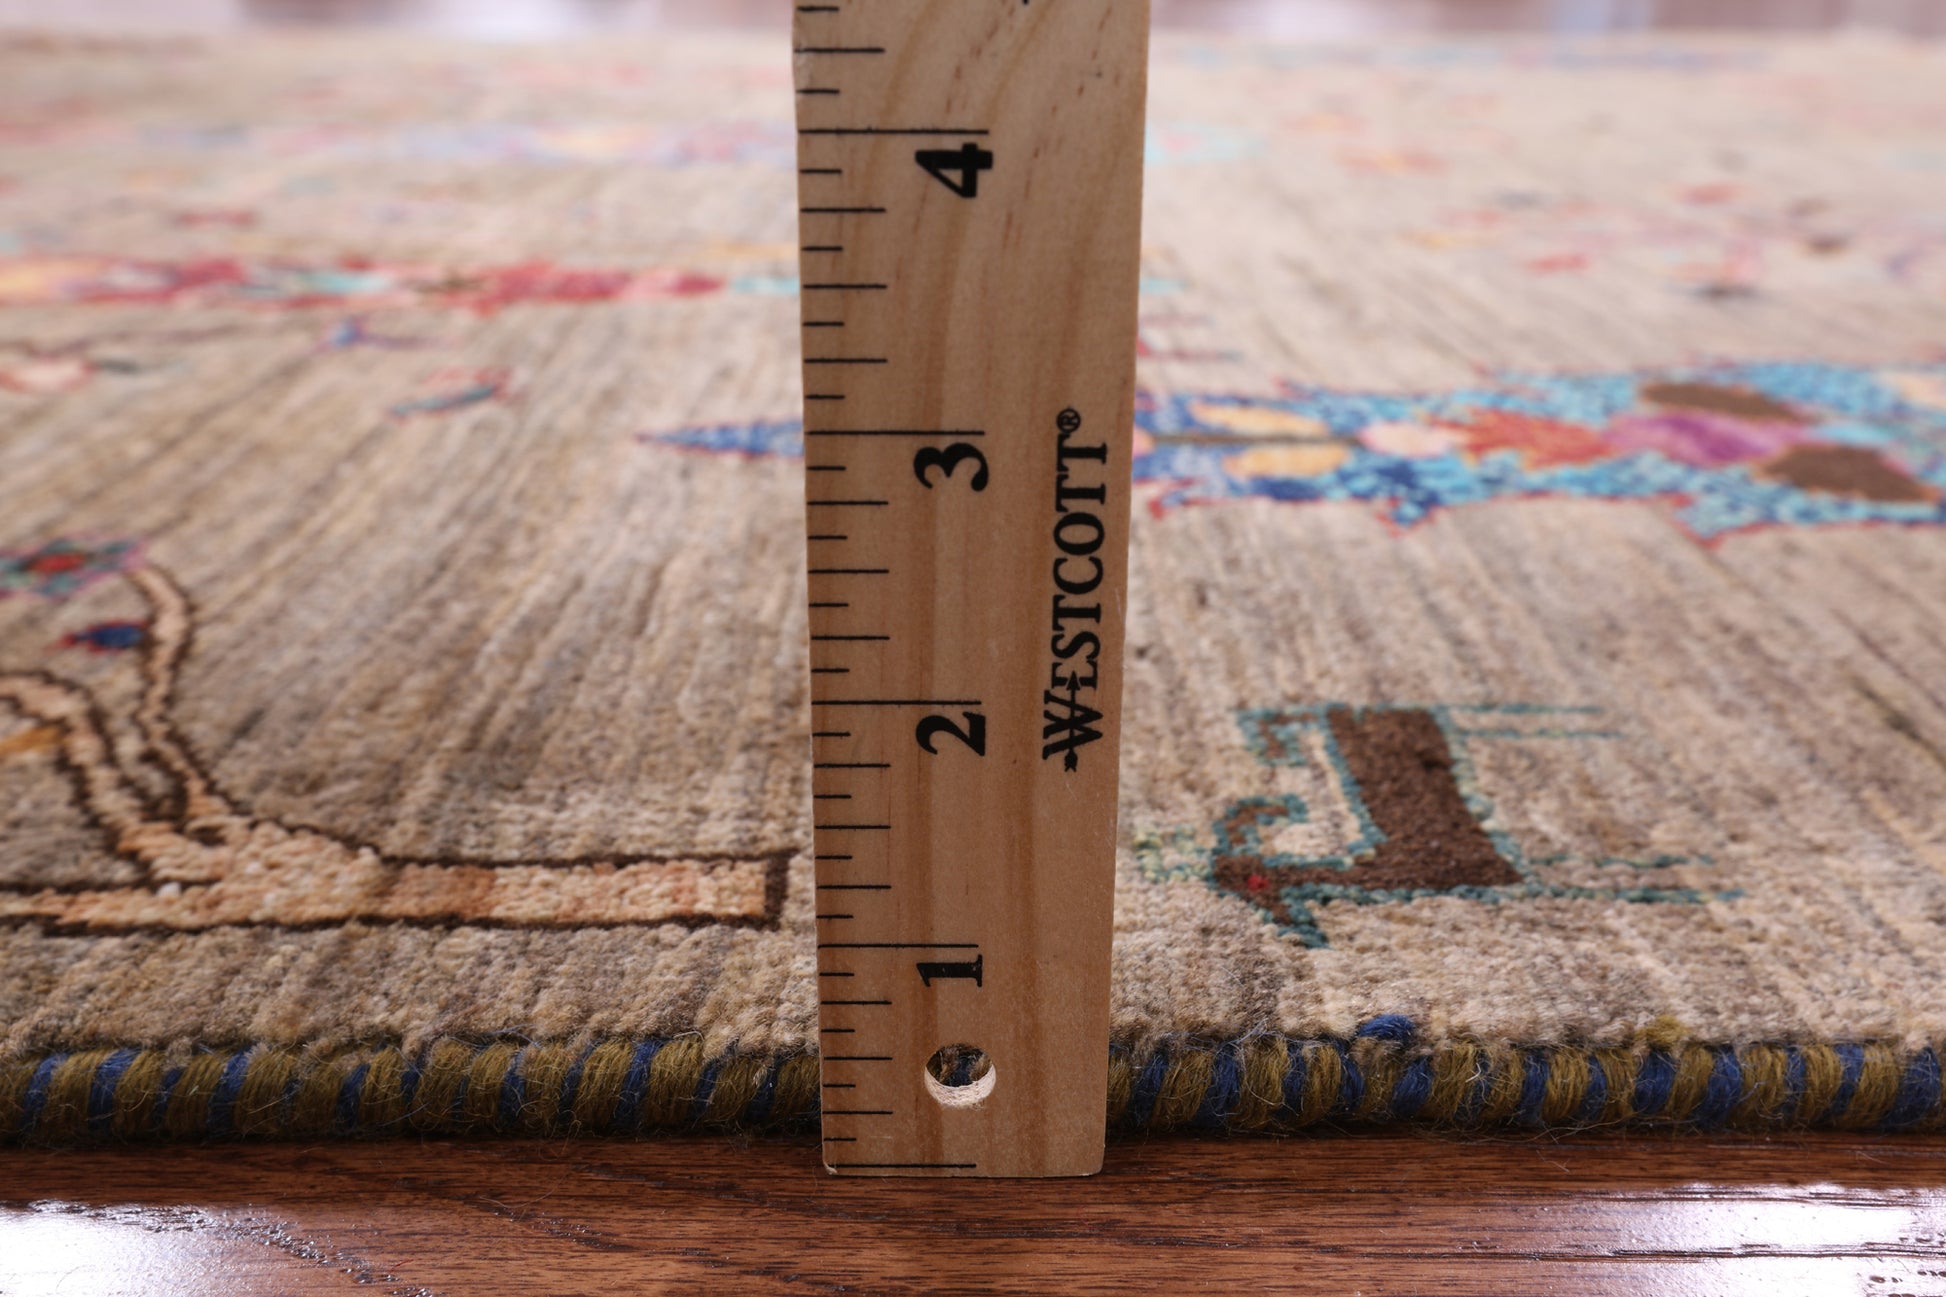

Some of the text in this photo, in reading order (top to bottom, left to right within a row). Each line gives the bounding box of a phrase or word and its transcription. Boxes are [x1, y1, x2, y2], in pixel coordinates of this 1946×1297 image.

[913, 142, 994, 198] 4
[913, 442, 989, 492] 3
[915, 710, 986, 756] 2
[916, 954, 983, 987] 1
